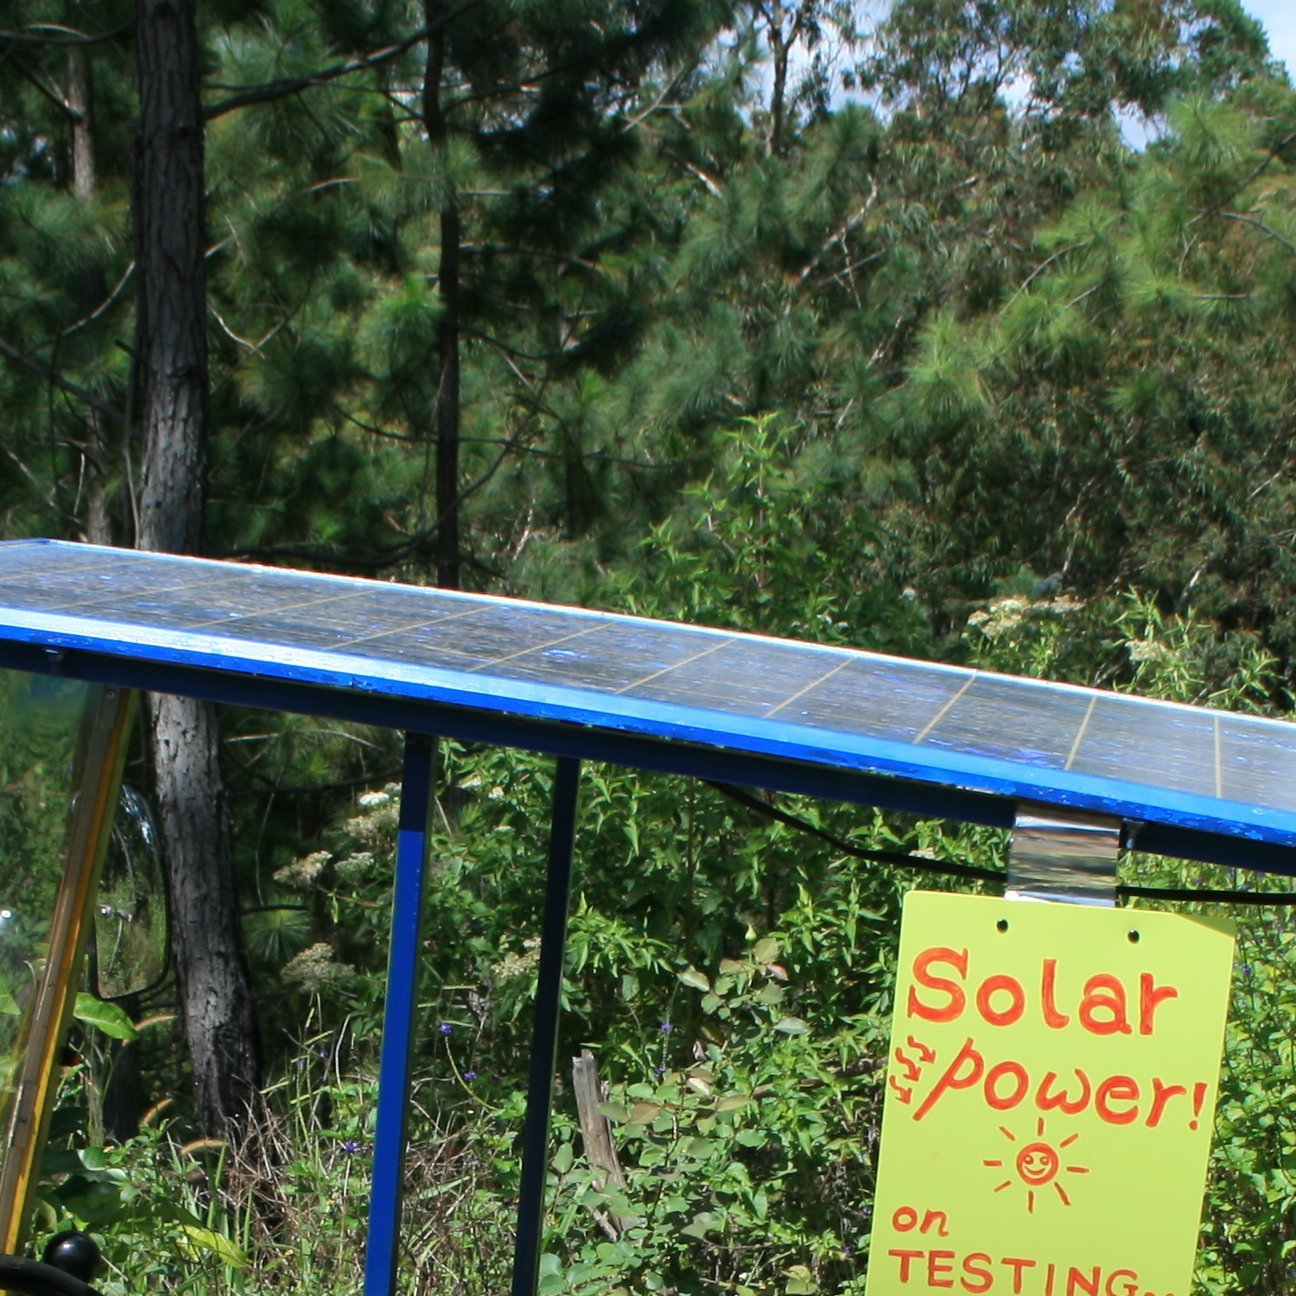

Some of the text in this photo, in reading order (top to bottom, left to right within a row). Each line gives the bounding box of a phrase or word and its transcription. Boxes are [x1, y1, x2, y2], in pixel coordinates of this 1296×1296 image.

[907, 946, 1179, 1036] Solar
[911, 1037, 1208, 1132] power!
[891, 1205, 950, 1238] on
